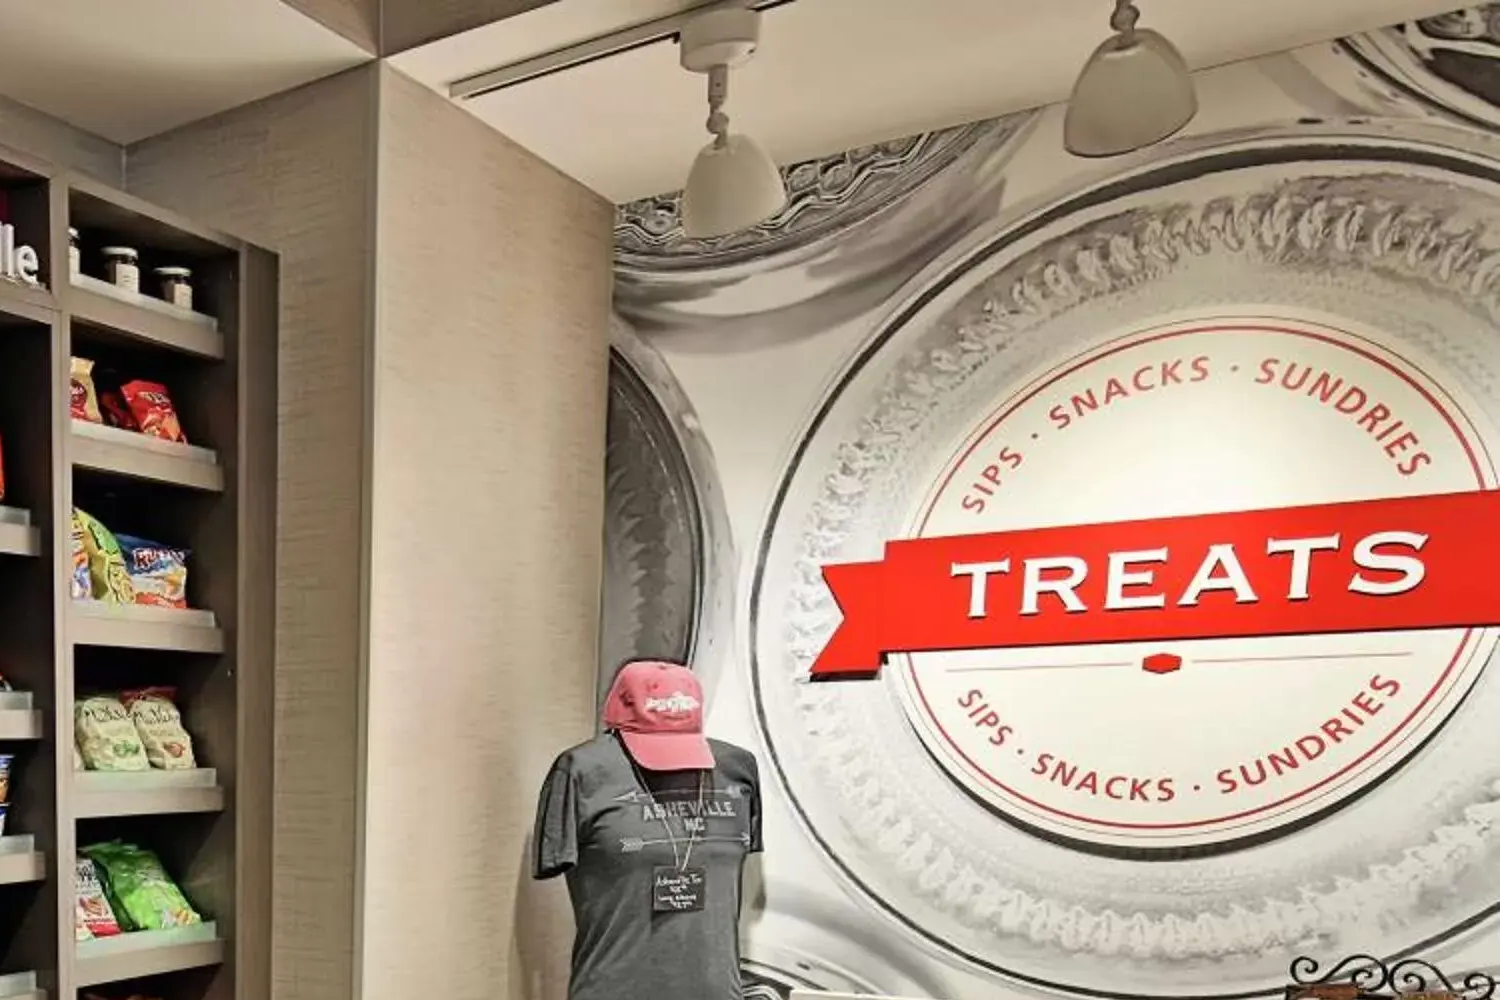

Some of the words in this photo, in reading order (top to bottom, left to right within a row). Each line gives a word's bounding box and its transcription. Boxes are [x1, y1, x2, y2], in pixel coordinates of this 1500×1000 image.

[960, 445, 1024, 516] SIPS
[1049, 355, 1211, 431] SNACKS
[1253, 355, 1434, 479] SUNDRIES
[950, 530, 1432, 621] TREATS
[957, 687, 1014, 748] SIPS
[1030, 751, 1176, 803] SNACKS
[1216, 672, 1402, 795] SUNDRIES
[643, 800, 737, 821] ASHEVILLE
